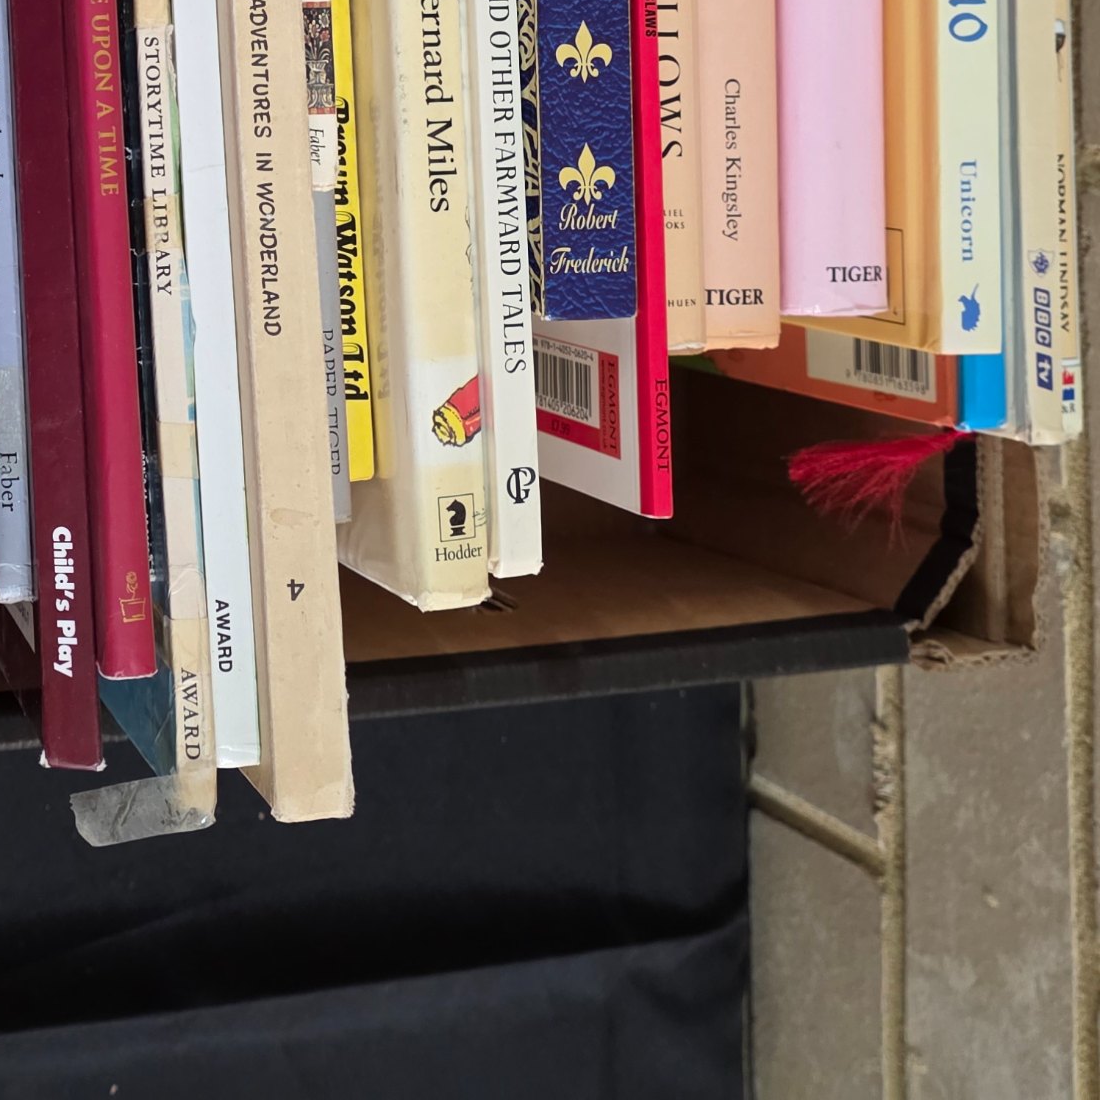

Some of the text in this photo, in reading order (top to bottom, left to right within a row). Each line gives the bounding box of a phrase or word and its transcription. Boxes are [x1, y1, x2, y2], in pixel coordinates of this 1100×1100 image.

[90, 13, 114, 93] UPON
[490, 30, 513, 123] OTHER
[95, 100, 115, 120] A
[307, 128, 325, 166] Faber
[97, 125, 120, 197] TIME
[143, 36, 174, 297] STORYTIME LIBRARY
[255, 151, 275, 173] IN
[426, 117, 457, 212] Miles
[494, 130, 521, 276] FARMYARD
[720, 79, 744, 241] Charles Kingsley
[558, 203, 618, 232] Robert
[959, 158, 977, 263] Unicorn
[255, 181, 282, 338] WONDERLAND
[549, 246, 629, 276] Frederick
[704, 288, 765, 306] TIGER
[826, 265, 883, 283] TIGER
[336, 209, 369, 401] Watson Ltd
[501, 282, 527, 374] TALES
[1033, 287, 1051, 349] BBC
[607, 361, 619, 455] EGMONT
[654, 377, 670, 473] EGMONT
[286, 578, 305, 602] 4
[434, 543, 483, 562] Hodder
[51, 526, 78, 679] Child's Play
[214, 599, 233, 673] AWARD
[180, 667, 202, 761] AWARD
